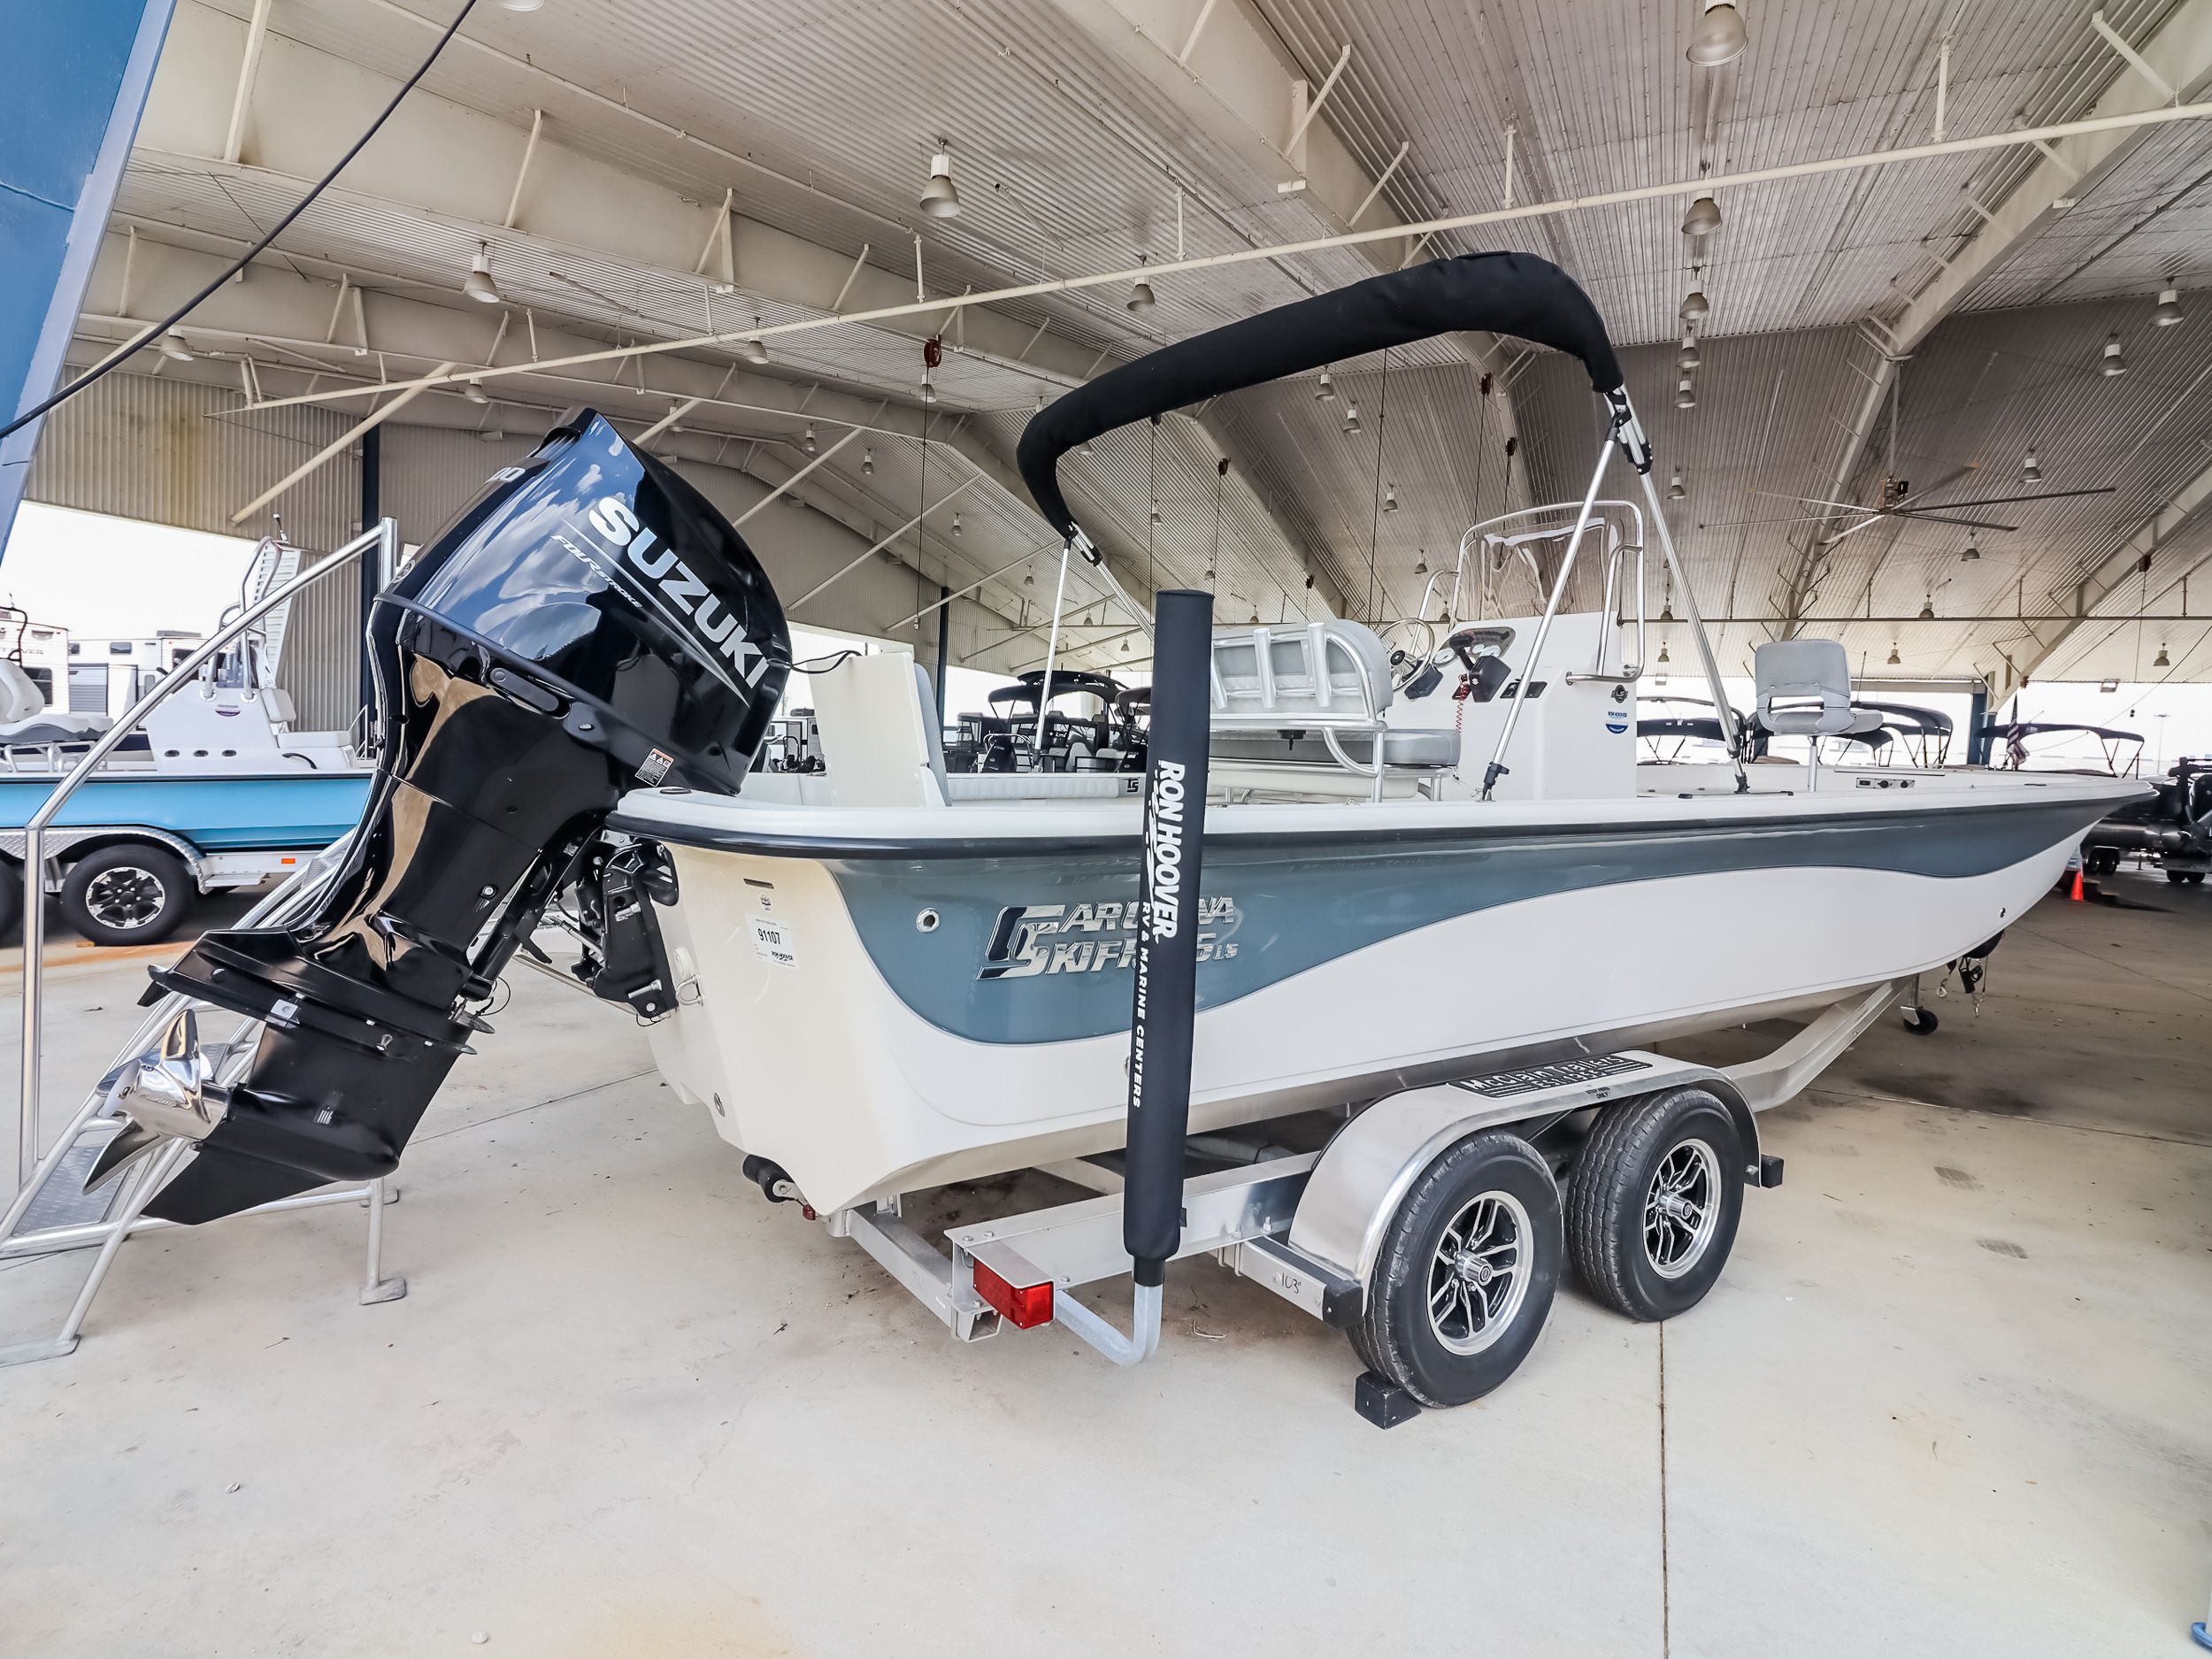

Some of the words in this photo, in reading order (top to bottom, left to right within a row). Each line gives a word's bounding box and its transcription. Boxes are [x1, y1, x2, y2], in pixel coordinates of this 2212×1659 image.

[588, 496, 770, 688] SUZUKI
[1157, 759, 1186, 822] RON
[1153, 822, 1183, 942] HOOVER
[757, 927, 780, 945] 91107
[1141, 901, 1150, 927] RV
[1141, 929, 1149, 941] &
[1137, 947, 1148, 1019] MARINE
[1133, 1024, 1145, 1108] CENTERS
[1461, 1070, 1553, 1090] McClain
[1543, 1054, 1624, 1073] Trailers
